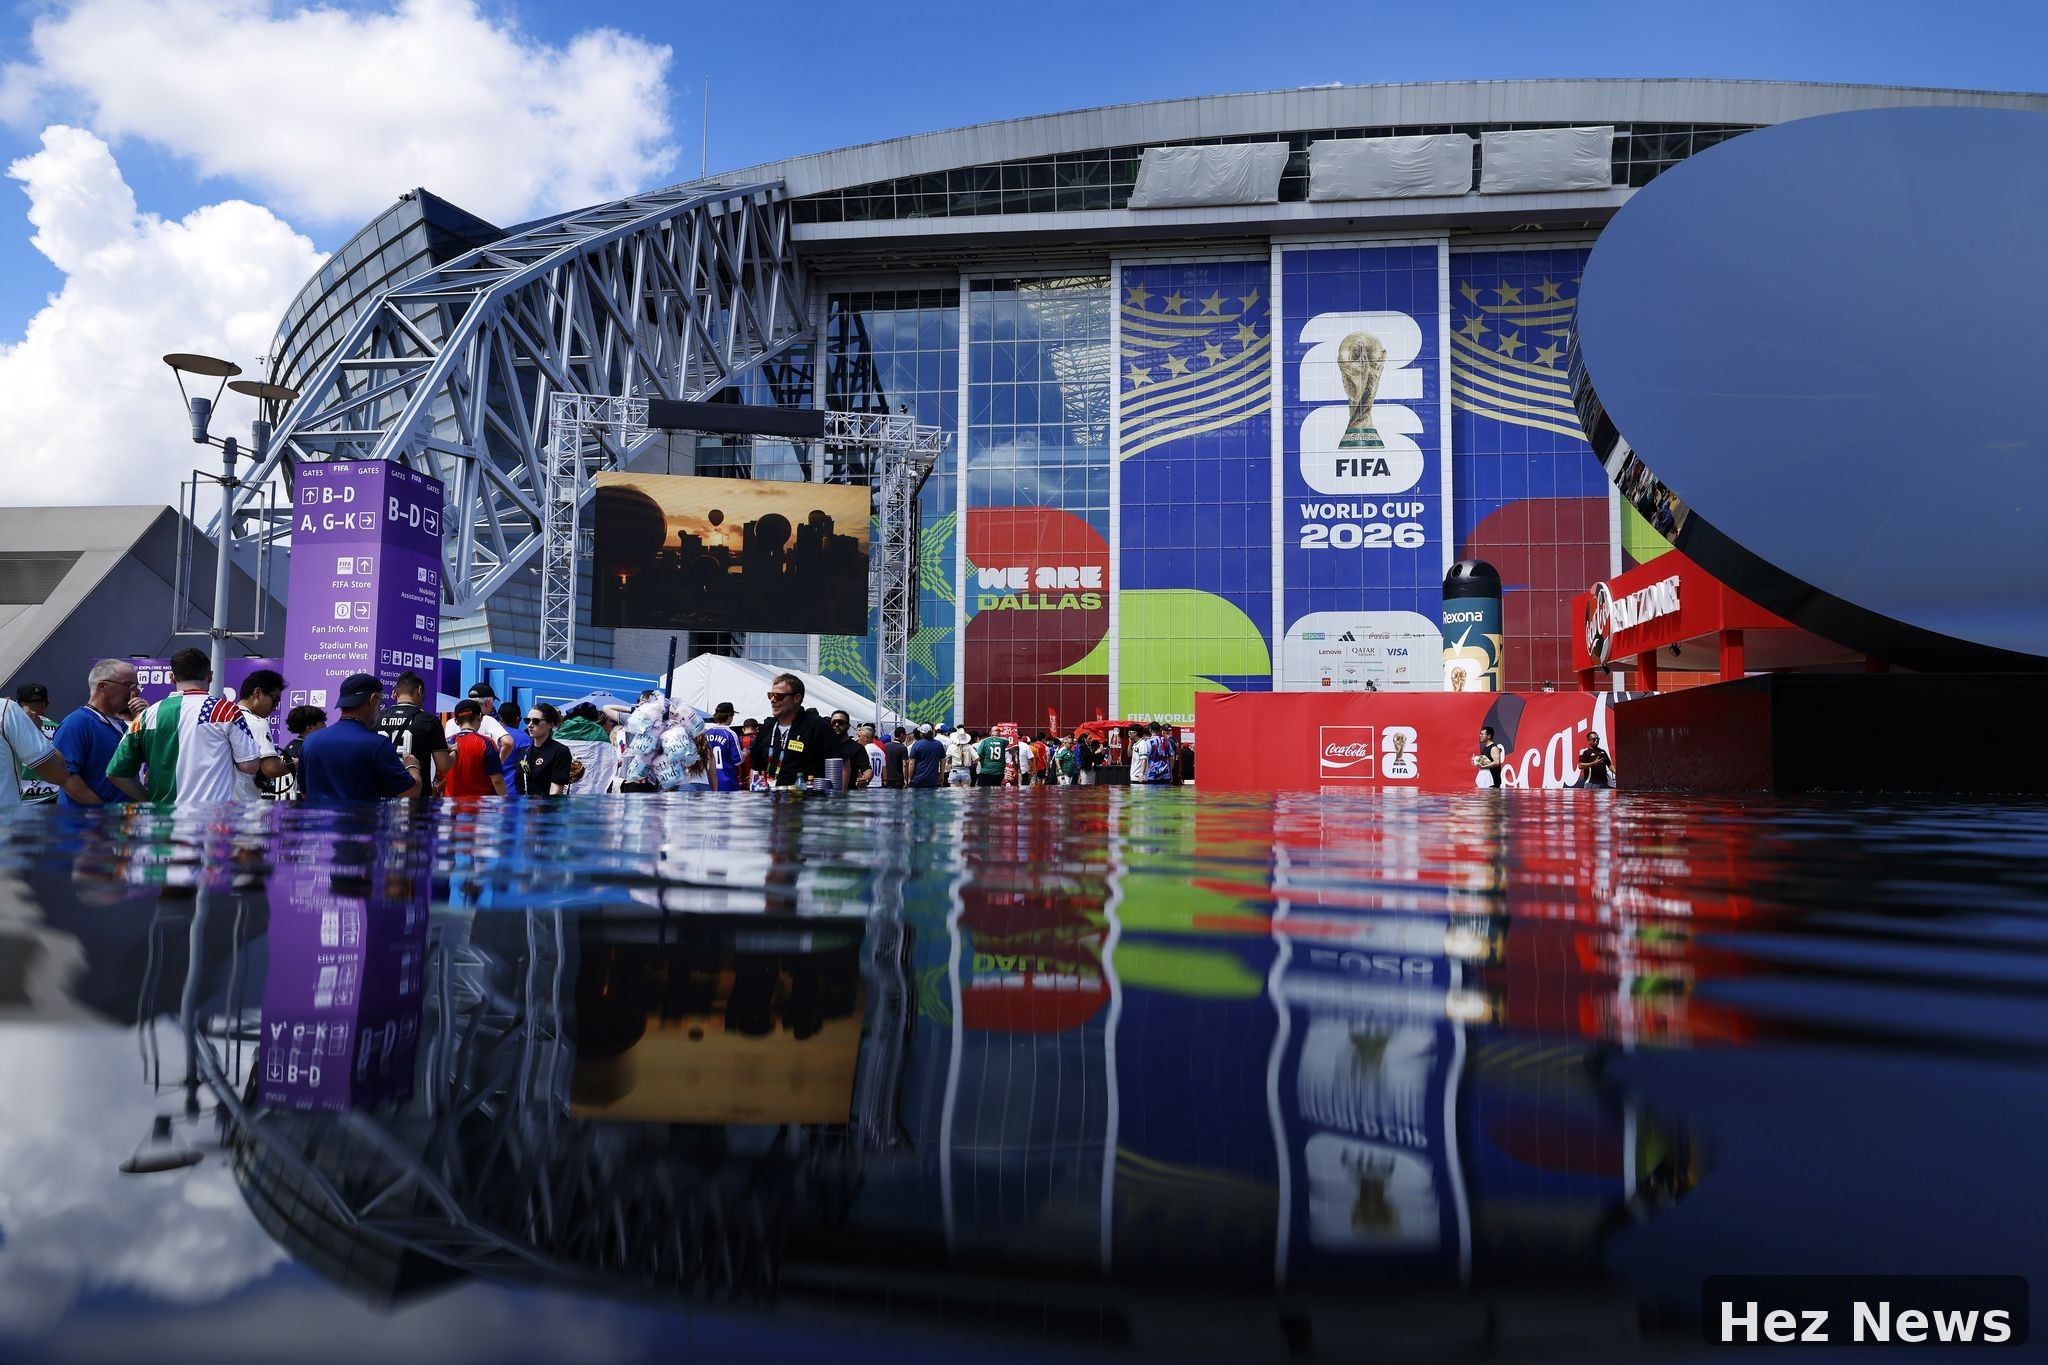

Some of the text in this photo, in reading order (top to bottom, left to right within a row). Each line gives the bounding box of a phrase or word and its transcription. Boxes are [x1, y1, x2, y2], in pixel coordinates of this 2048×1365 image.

[1336, 458, 1391, 477] FIFA
[391, 470, 406, 481] GATES
[411, 474, 422, 484] FIFA
[426, 484, 440, 495] GATES
[1300, 502, 1425, 519] WORLD CUP
[1300, 522, 1425, 549] 2026
[977, 566, 1029, 591] WE
[332, 580, 372, 589] FIFA Store
[977, 593, 1102, 611] DALLAS
[1442, 610, 1484, 624] Rexona
[311, 625, 369, 634] Fan Info. Point
[412, 633, 435, 644] FIFA Store
[319, 641, 368, 650] Stadium Fan
[304, 652, 368, 662] Experience West
[1387, 648, 1409, 656] VISA
[325, 668, 355, 678] Lounge
[1127, 713, 1195, 723] FIFA WORLD
[989, 746, 1002, 760] 19
[1324, 742, 1369, 757] Coca-Cola
[660, 765, 681, 781] andy
